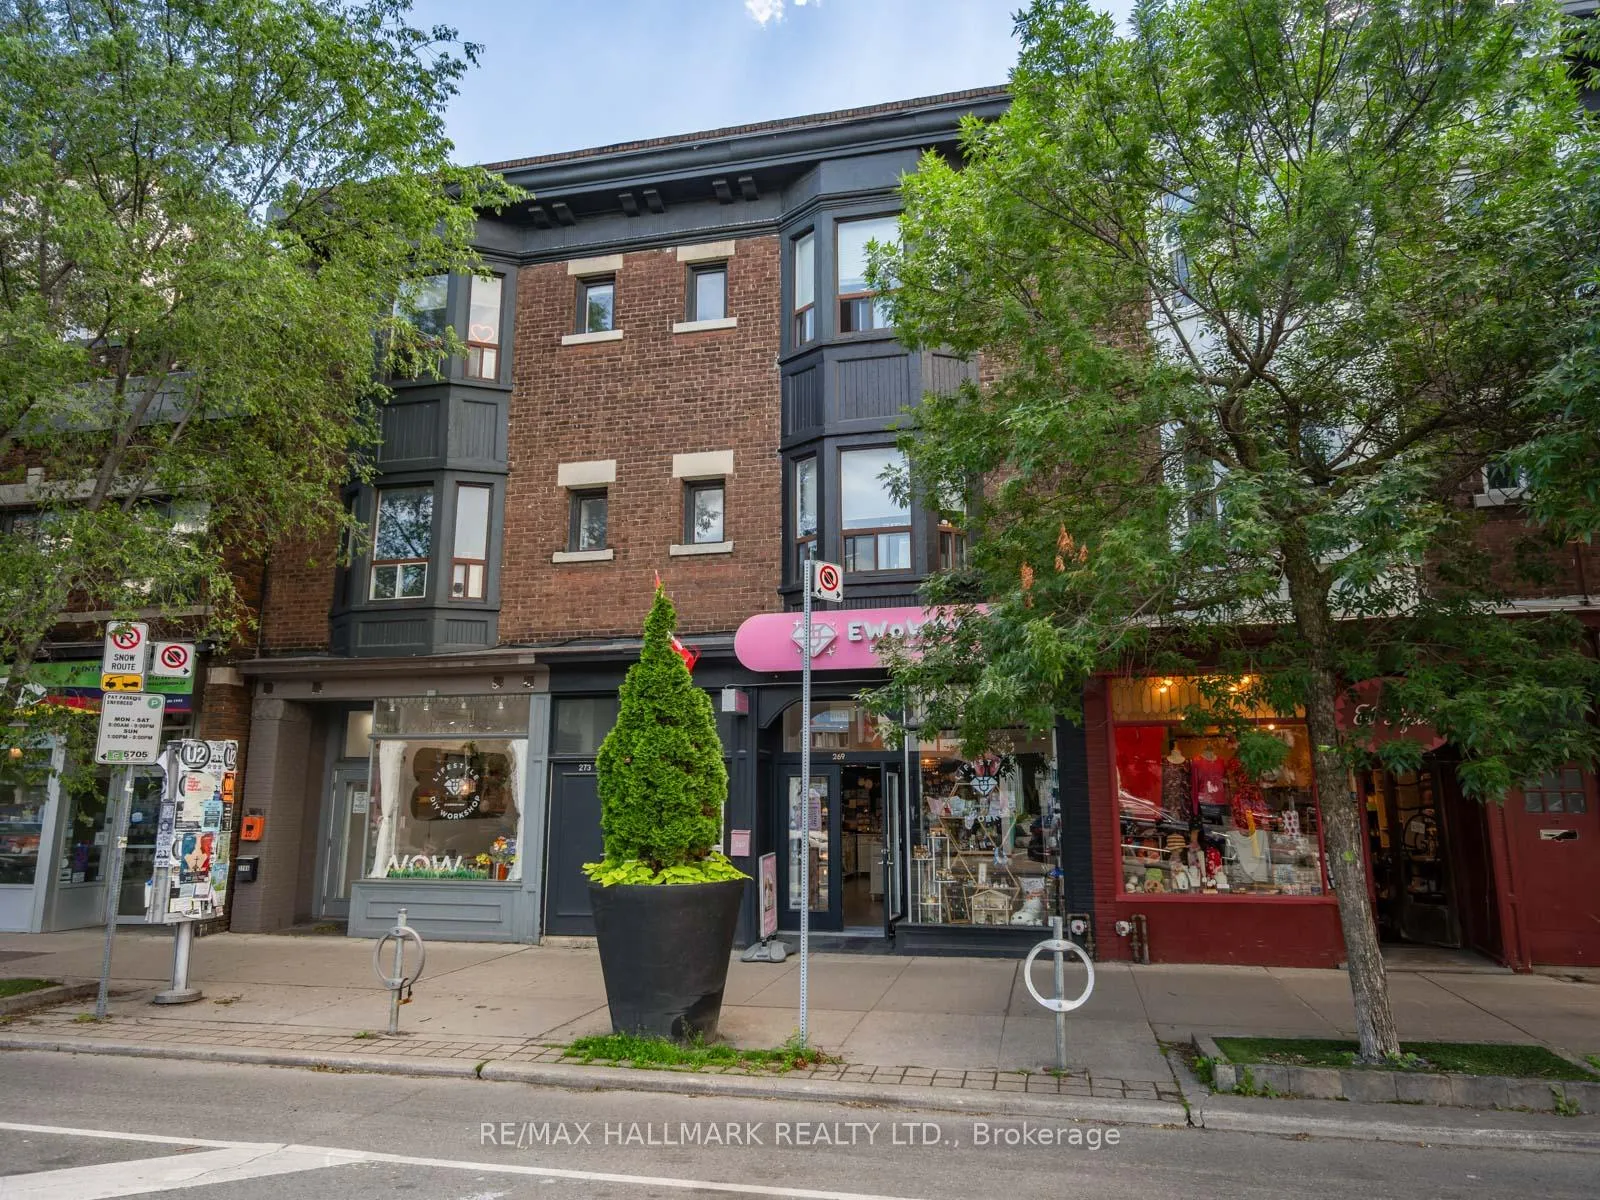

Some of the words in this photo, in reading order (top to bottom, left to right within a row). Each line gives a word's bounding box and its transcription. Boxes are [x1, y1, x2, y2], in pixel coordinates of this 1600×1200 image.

[111, 662, 136, 671] ROUTE
[113, 654, 136, 662] SNOW
[123, 750, 148, 758] 5705
[186, 745, 206, 763] U2
[227, 748, 238, 765] U2
[432, 762, 480, 782] LIFESTYLE
[430, 796, 440, 810] DIY
[440, 795, 480, 820] WORKSHOP
